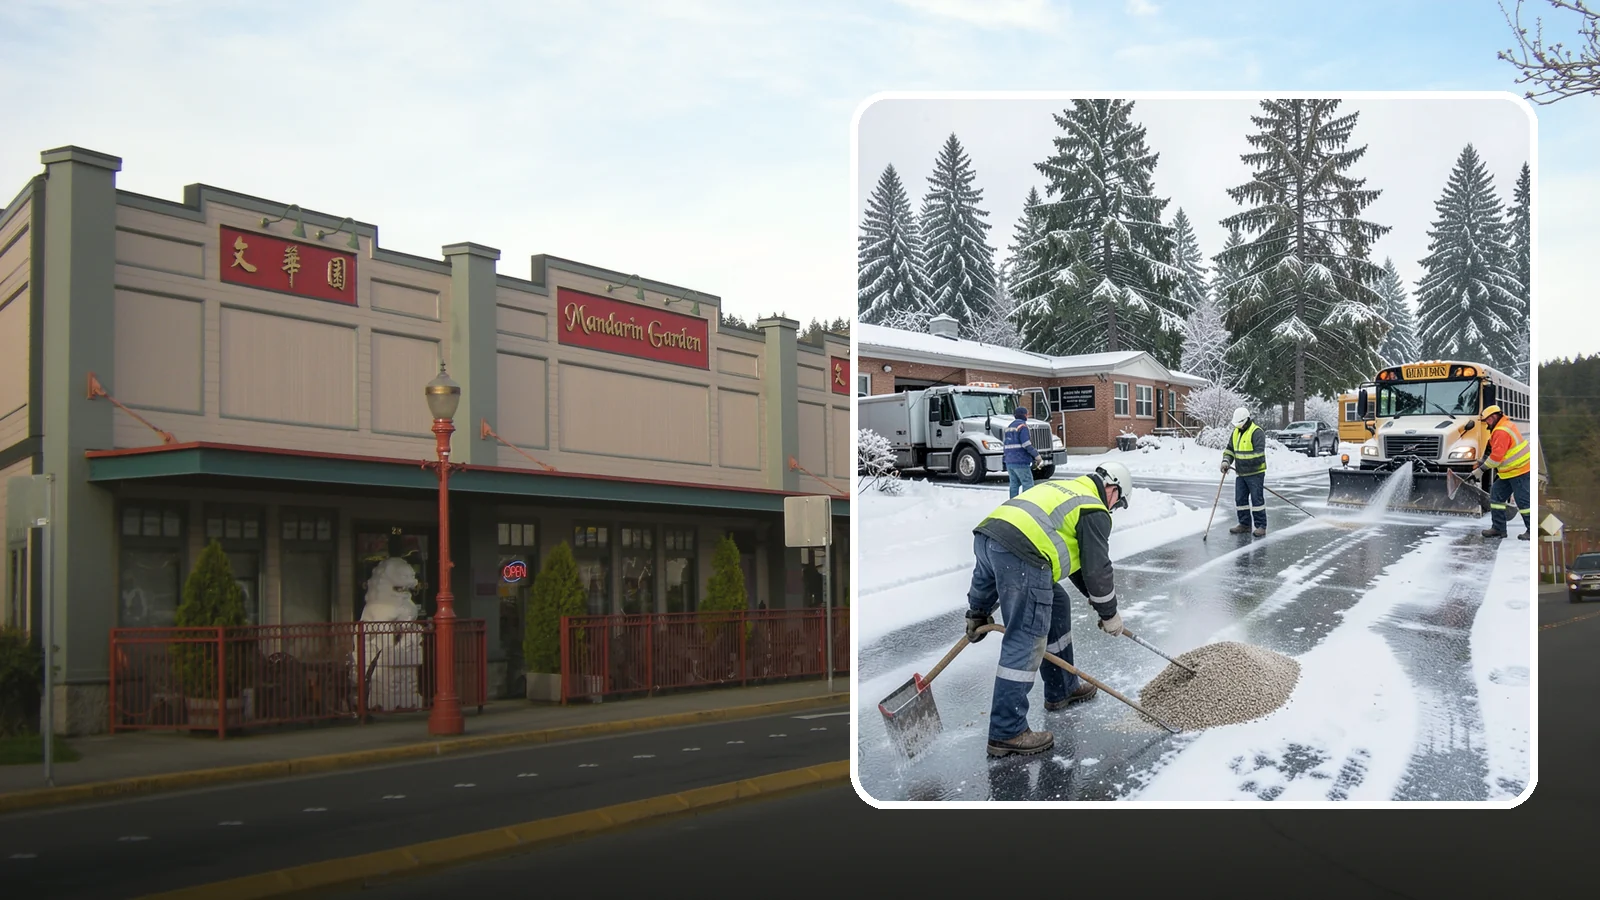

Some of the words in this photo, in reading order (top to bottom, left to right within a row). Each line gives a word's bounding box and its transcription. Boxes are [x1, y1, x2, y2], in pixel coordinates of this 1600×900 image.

[230, 235, 346, 291] 文華園
[564, 302, 644, 341] Mandarin
[648, 320, 702, 352] Garden
[503, 565, 527, 578] OPEN
